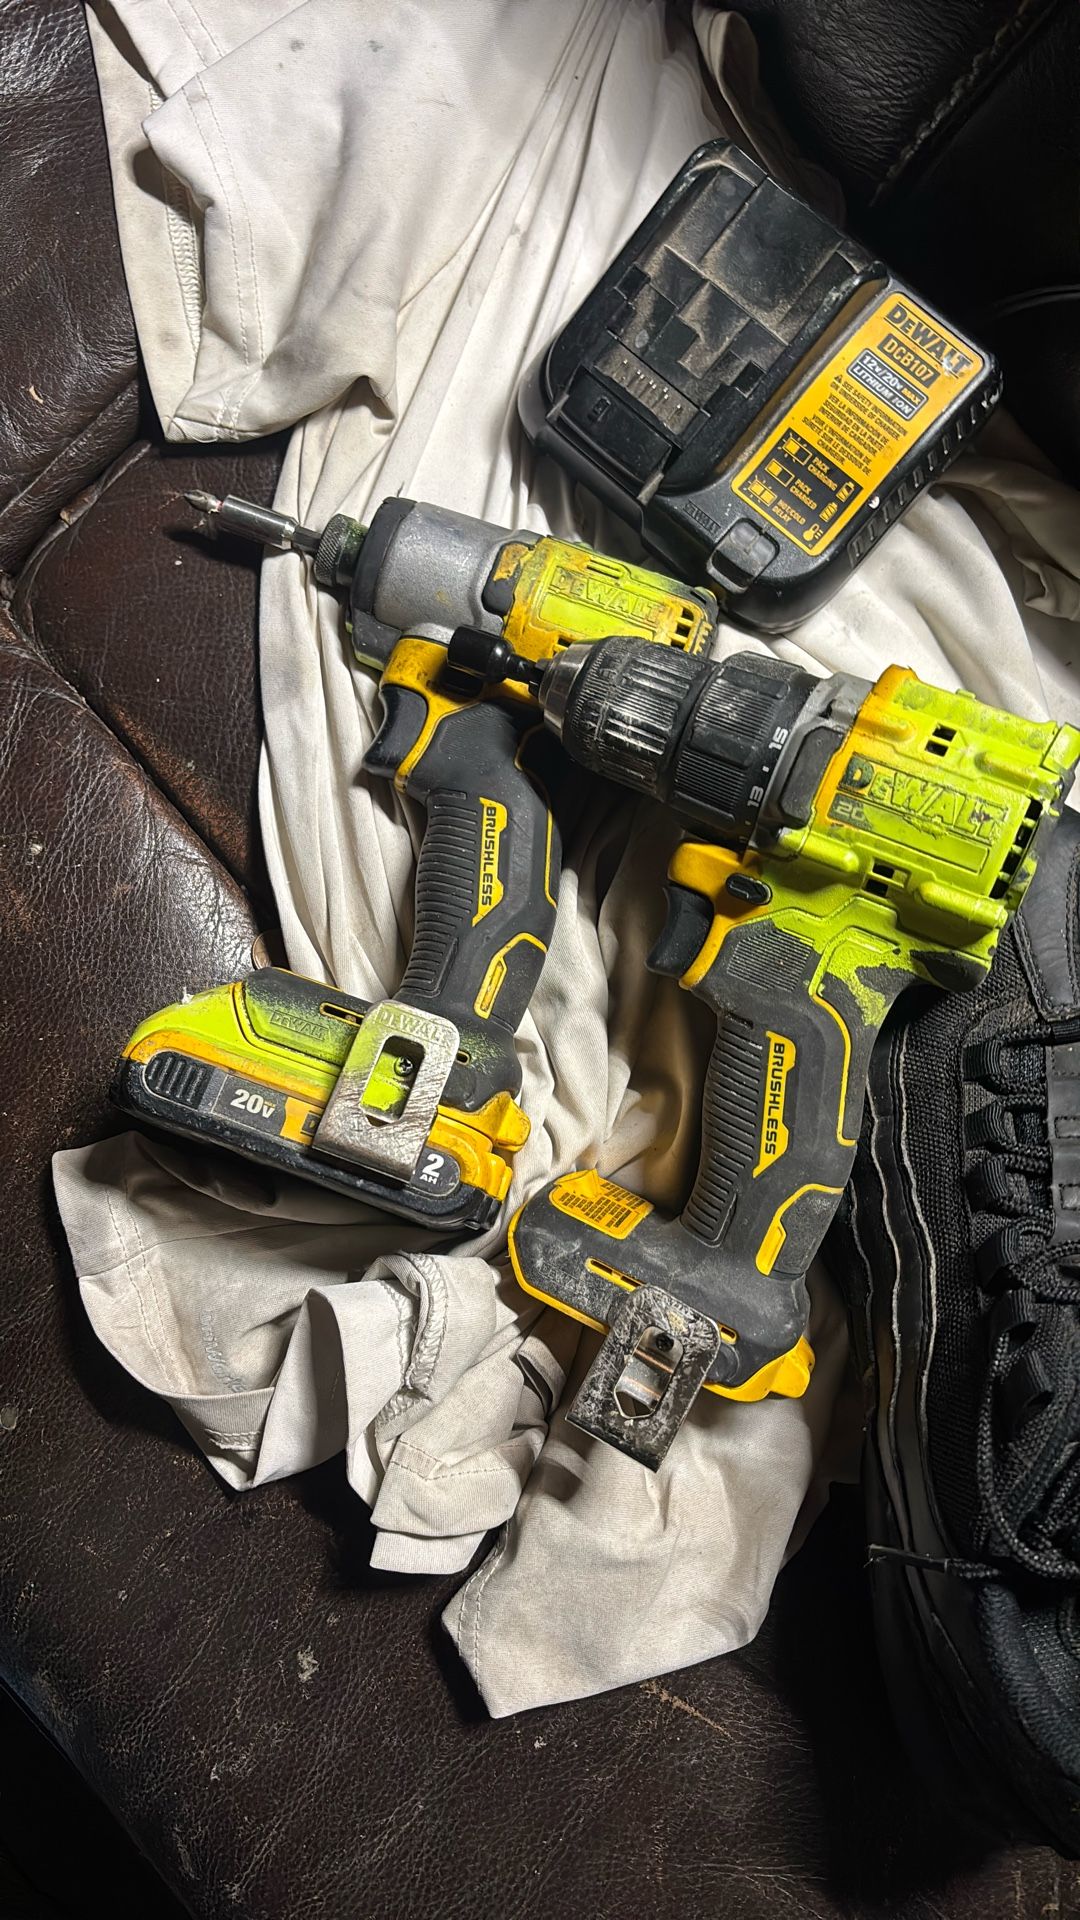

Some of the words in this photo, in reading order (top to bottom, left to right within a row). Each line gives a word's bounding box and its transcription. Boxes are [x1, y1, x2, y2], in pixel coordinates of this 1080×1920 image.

[883, 338, 935, 383] DCB107
[853, 365, 893, 399] LITHIUM
[892, 397, 912, 414] ION
[901, 388, 921, 405] MAX
[838, 389, 869, 414] UNDERSIDE
[868, 412, 876, 420] OF
[842, 381, 853, 392] SEE
[852, 390, 872, 407] SAFETY
[871, 405, 908, 436] INFORMATION
[828, 394, 839, 404] VER
[838, 402, 846, 410] LA
[880, 436, 889, 445] DE
[841, 425, 849, 433] DE
[852, 423, 861, 432] EN
[860, 430, 868, 438] LA
[866, 436, 884, 451] PARTE
[812, 457, 830, 473] PACK
[821, 433, 833, 444] SUR
[838, 447, 864, 469] DESSOUS
[863, 467, 871, 475] DE
[863, 457, 871, 465] DE
[794, 479, 812, 495] PACK
[807, 464, 838, 491] CHARGING
[789, 486, 818, 510] CHARGED
[772, 506, 792, 523] DELAY
[768, 726, 788, 750] 15
[747, 785, 764, 807] 13
[840, 755, 1007, 842] DEWALT
[481, 806, 496, 906] BRUSHLESS
[765, 1042, 785, 1155] BRUSHLESS
[422, 1154, 444, 1178] 2
